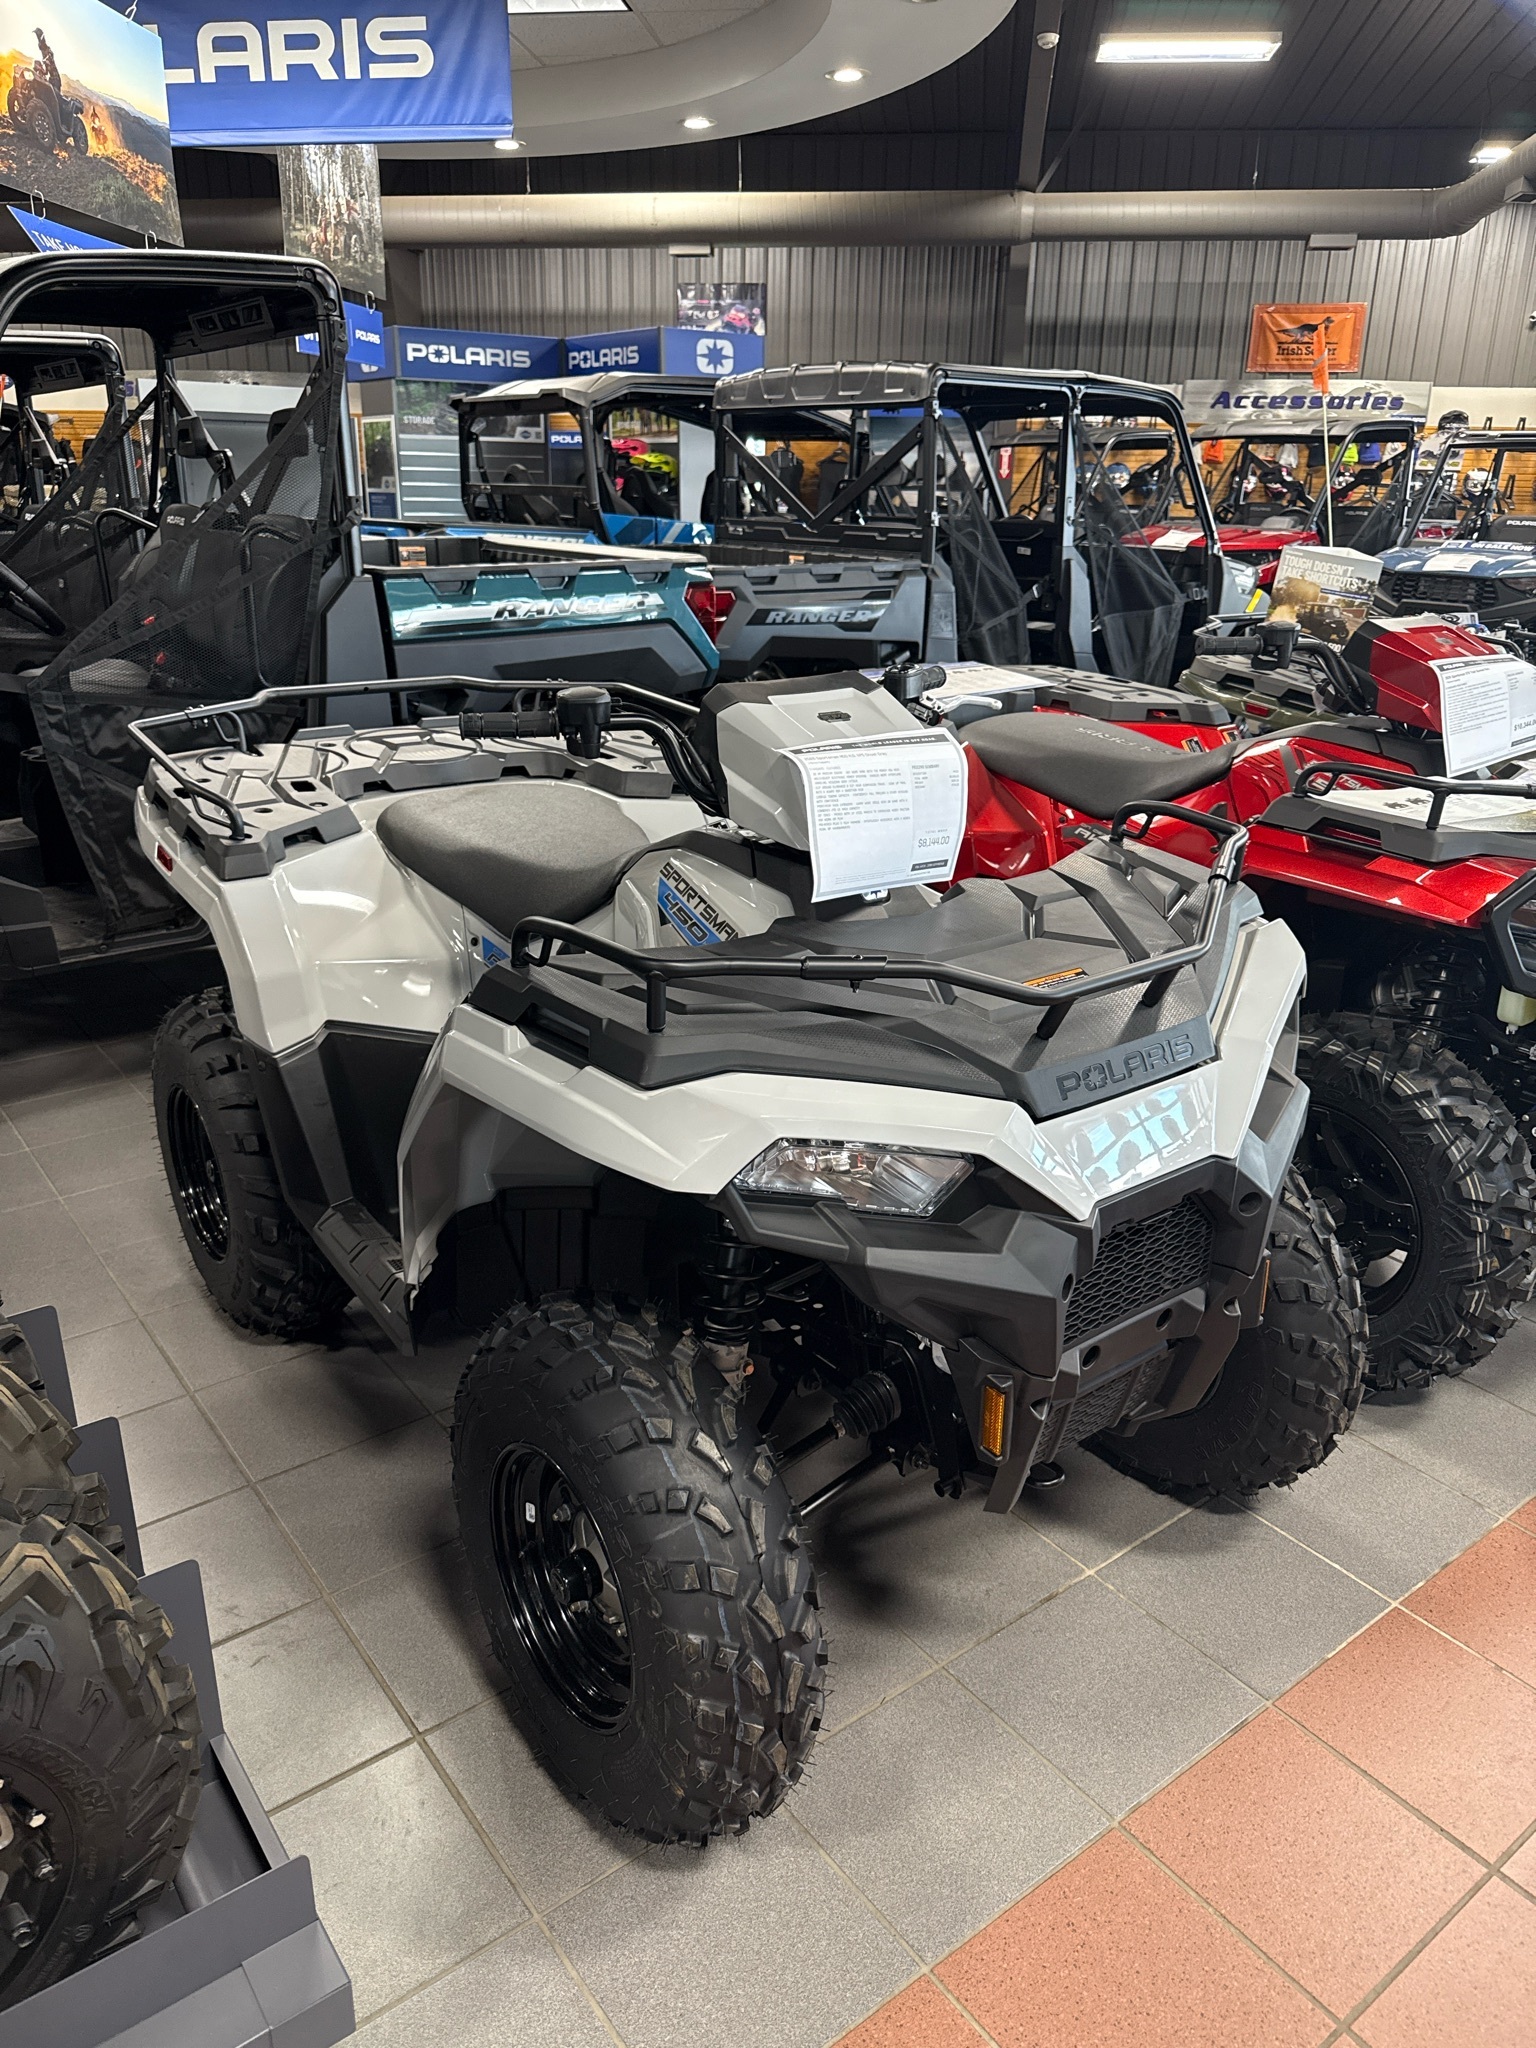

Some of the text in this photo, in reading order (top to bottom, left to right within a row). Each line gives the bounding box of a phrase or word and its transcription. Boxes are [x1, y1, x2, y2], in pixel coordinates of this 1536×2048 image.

[143, 15, 435, 84] LARIS
[354, 329, 381, 344] POLARIS
[406, 342, 532, 368] POLARIS
[567, 345, 640, 370] POLARIS
[1276, 346, 1337, 356] Irish Seer
[1210, 391, 1405, 411] Accessories
[403, 416, 436, 425] STORAGE
[550, 434, 583, 444] POLA
[1281, 566, 1303, 579] TAKE
[1284, 554, 1355, 577] TOUGH DOESN'T
[492, 592, 653, 620] RANGER
[765, 609, 874, 625] RANGER
[917, 836, 950, 848] $8,144.00
[659, 862, 741, 941] SPORTSMA
[664, 892, 710, 943] 450
[1055, 1033, 1194, 1102] POLARIS
